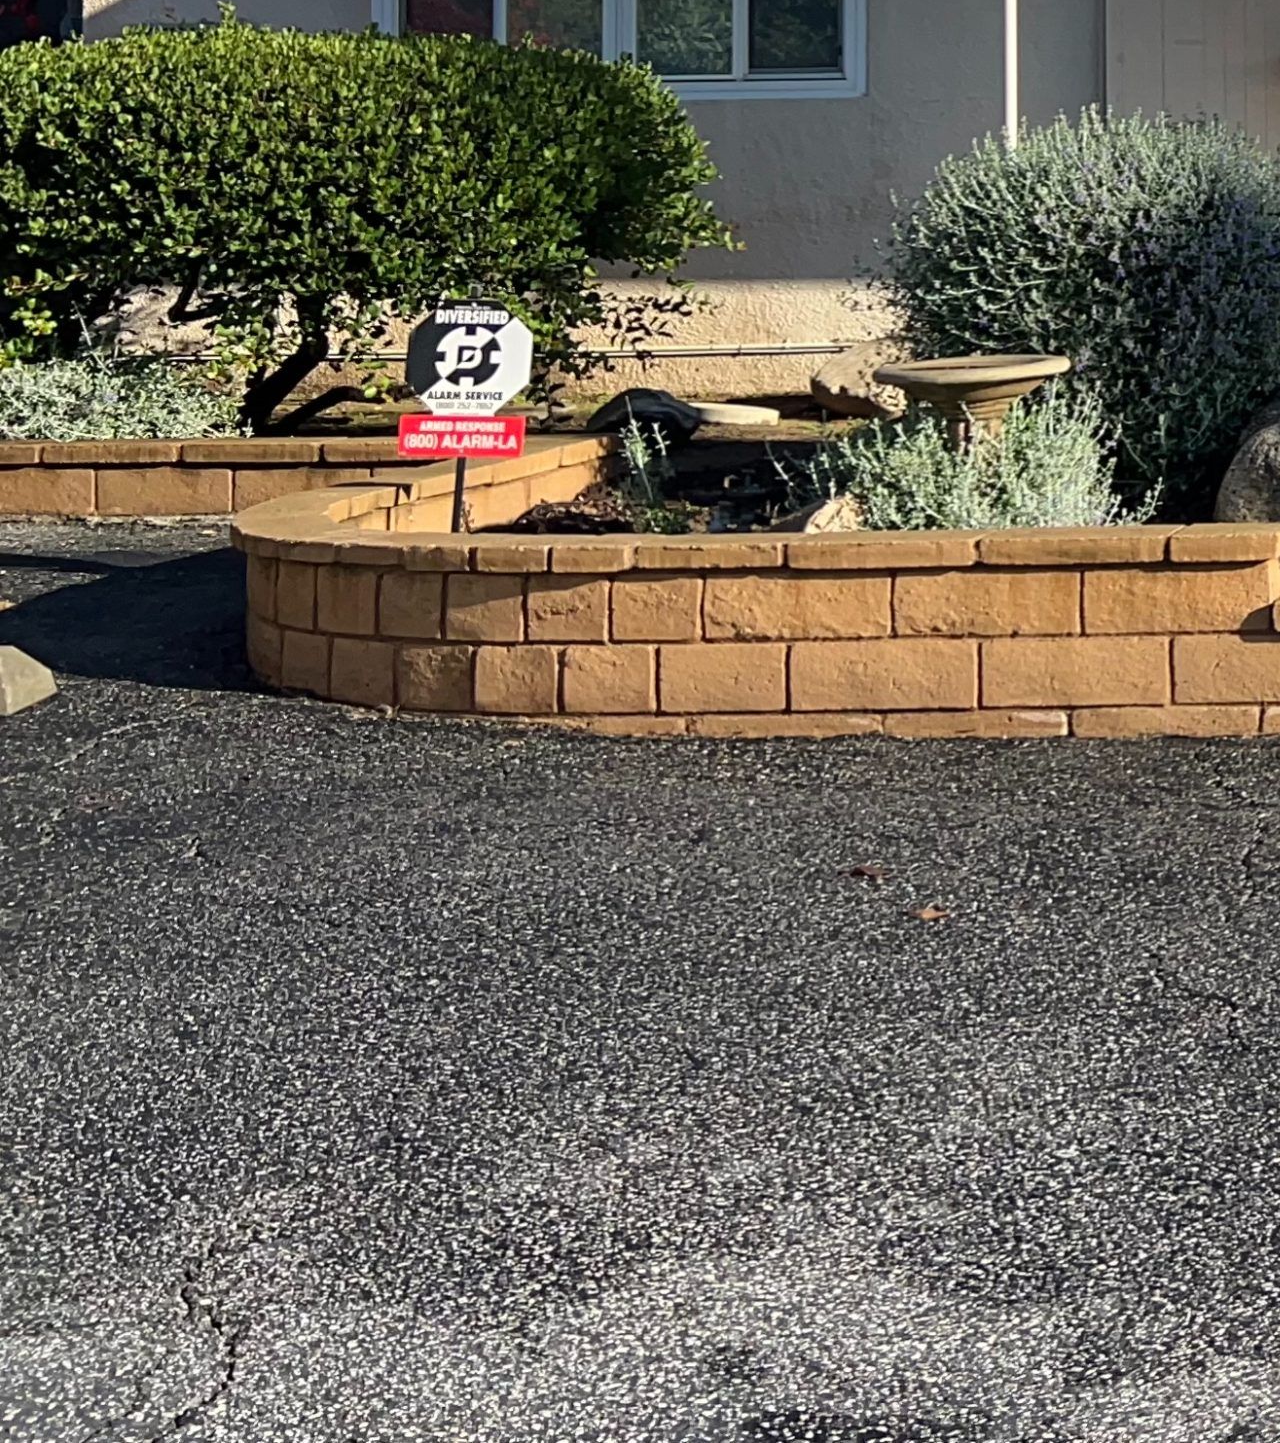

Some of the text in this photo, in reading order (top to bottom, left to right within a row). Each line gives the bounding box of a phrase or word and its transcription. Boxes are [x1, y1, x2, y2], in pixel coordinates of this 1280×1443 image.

[435, 310, 509, 325] DIVERSIFIED
[427, 391, 503, 401] ALARM SERVICE
[419, 421, 505, 433] ARMED RESPONSE
[404, 433, 517, 449] (800) ALARM-LA
